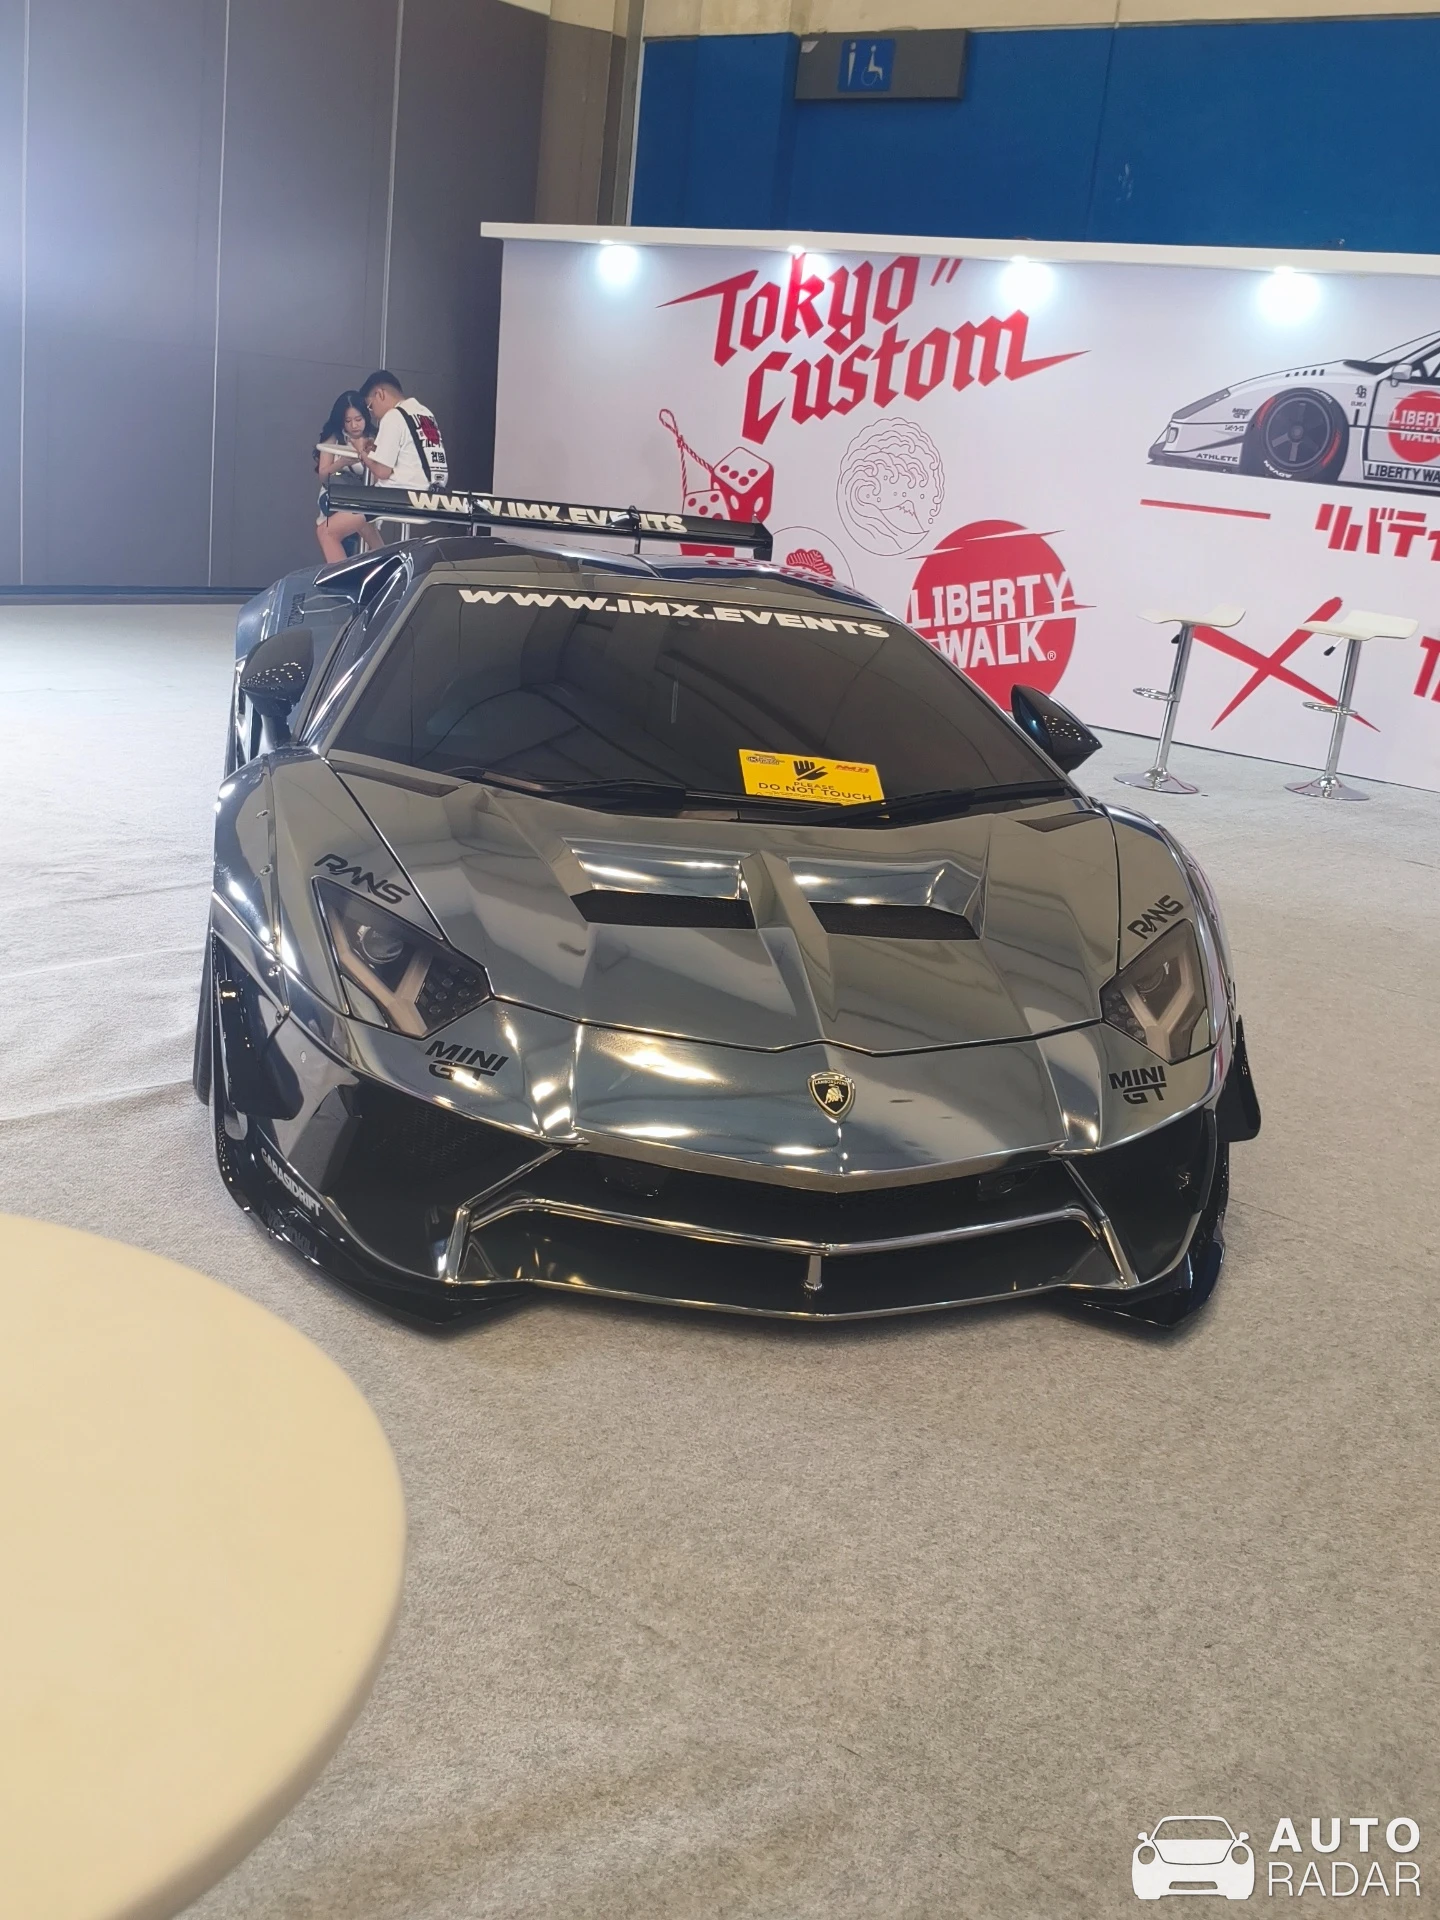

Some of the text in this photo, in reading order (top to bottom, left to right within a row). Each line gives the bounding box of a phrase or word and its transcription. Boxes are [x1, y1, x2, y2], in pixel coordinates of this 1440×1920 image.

[741, 309, 1091, 445] Custom
[1196, 453, 1239, 463] ATHLETE
[1367, 464, 1421, 481] LIBERTY
[907, 571, 1070, 629] LIBERTY
[458, 589, 890, 639] WWW.IMX.EVENTS
[936, 620, 1047, 669] WALK
[758, 782, 781, 791] DO
[785, 785, 816, 795] NOT
[822, 789, 873, 801] TOUCH
[793, 781, 835, 791] PLEASE
[425, 1040, 509, 1072] MINI
[428, 1060, 498, 1082] GT
[1108, 1065, 1167, 1090] MINI
[1122, 1082, 1168, 1105] GT
